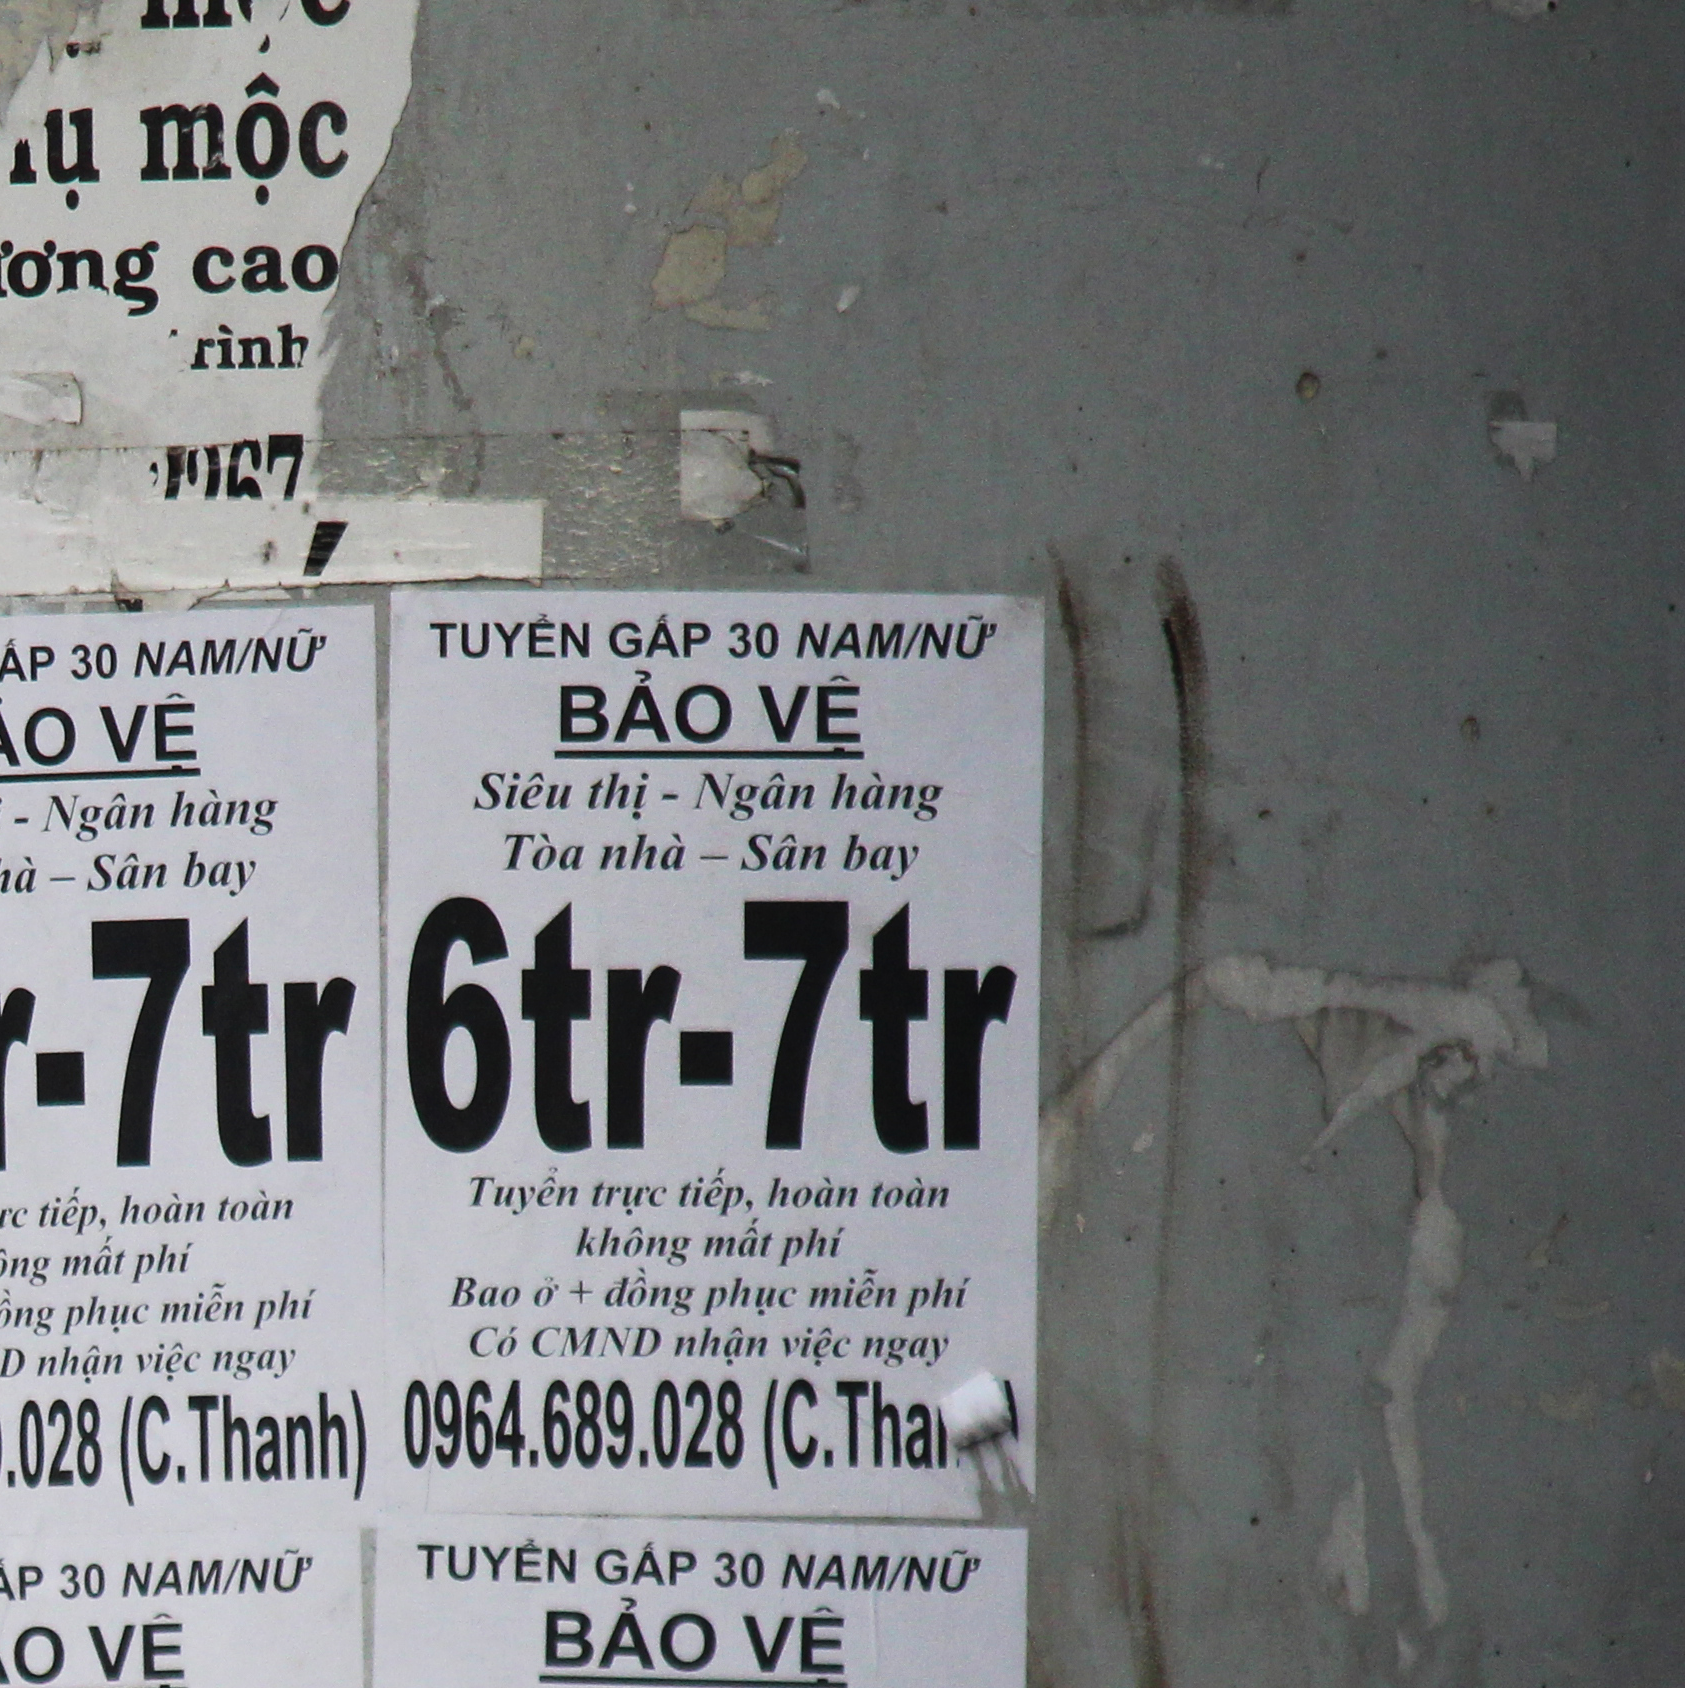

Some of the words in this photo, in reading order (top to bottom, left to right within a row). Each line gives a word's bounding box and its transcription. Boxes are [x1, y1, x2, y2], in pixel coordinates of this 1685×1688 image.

[140, 72, 350, 206] mộc
[192, 243, 340, 294] cao
[70, 642, 118, 681] 30
[134, 627, 328, 678] NAM/NỮ
[429, 613, 590, 659] TUYỂN
[608, 613, 712, 659] GẤP
[728, 621, 779, 659] 30
[796, 614, 998, 660] NAM/NỮ
[98, 692, 198, 768] VỆ
[559, 669, 733, 744] BẢO
[757, 674, 861, 750] VỆ
[473, 772, 573, 810] Siêu
[587, 772, 650, 821] thị
[694, 772, 815, 822] Ngân
[830, 771, 944, 822] hàng
[504, 833, 585, 871] Tòa
[599, 833, 686, 871] nhà
[740, 833, 827, 872] Sân
[842, 833, 920, 882] bay
[407, 896, 1018, 1154] 6tr-7tr
[470, 1167, 579, 1214] Tuyển
[591, 1181, 668, 1216] trực
[678, 1167, 754, 1217] tiếp,
[767, 1176, 859, 1209] hoàn
[870, 1176, 950, 1209] toàn
[576, 1226, 692, 1271] không
[703, 1217, 773, 1258] mất
[779, 1226, 846, 1267] phí
[450, 1276, 521, 1308] Bao
[533, 1277, 560, 1307] ở
[604, 1268, 696, 1316] đồng
[702, 1276, 798, 1317] phục
[808, 1268, 897, 1309] miễn
[905, 1276, 972, 1318] phí
[469, 1326, 518, 1358] Có
[531, 1326, 662, 1358] CMND
[674, 1326, 768, 1367] nhận
[781, 1326, 851, 1367] việc
[862, 1335, 950, 1368] ngay
[119, 1389, 367, 1505] (C.Thanh)
[404, 1378, 745, 1470] 0964.689.028
[59, 1563, 106, 1600] 30
[122, 1549, 314, 1598] NAM/NỮ
[417, 1538, 577, 1584] TUYỂN
[594, 1541, 698, 1586] GẤP
[713, 1551, 765, 1589] 30
[781, 1549, 982, 1594] NAM/NỮ
[539, 1597, 717, 1679] BẢO
[742, 1606, 845, 1681] VỆ
